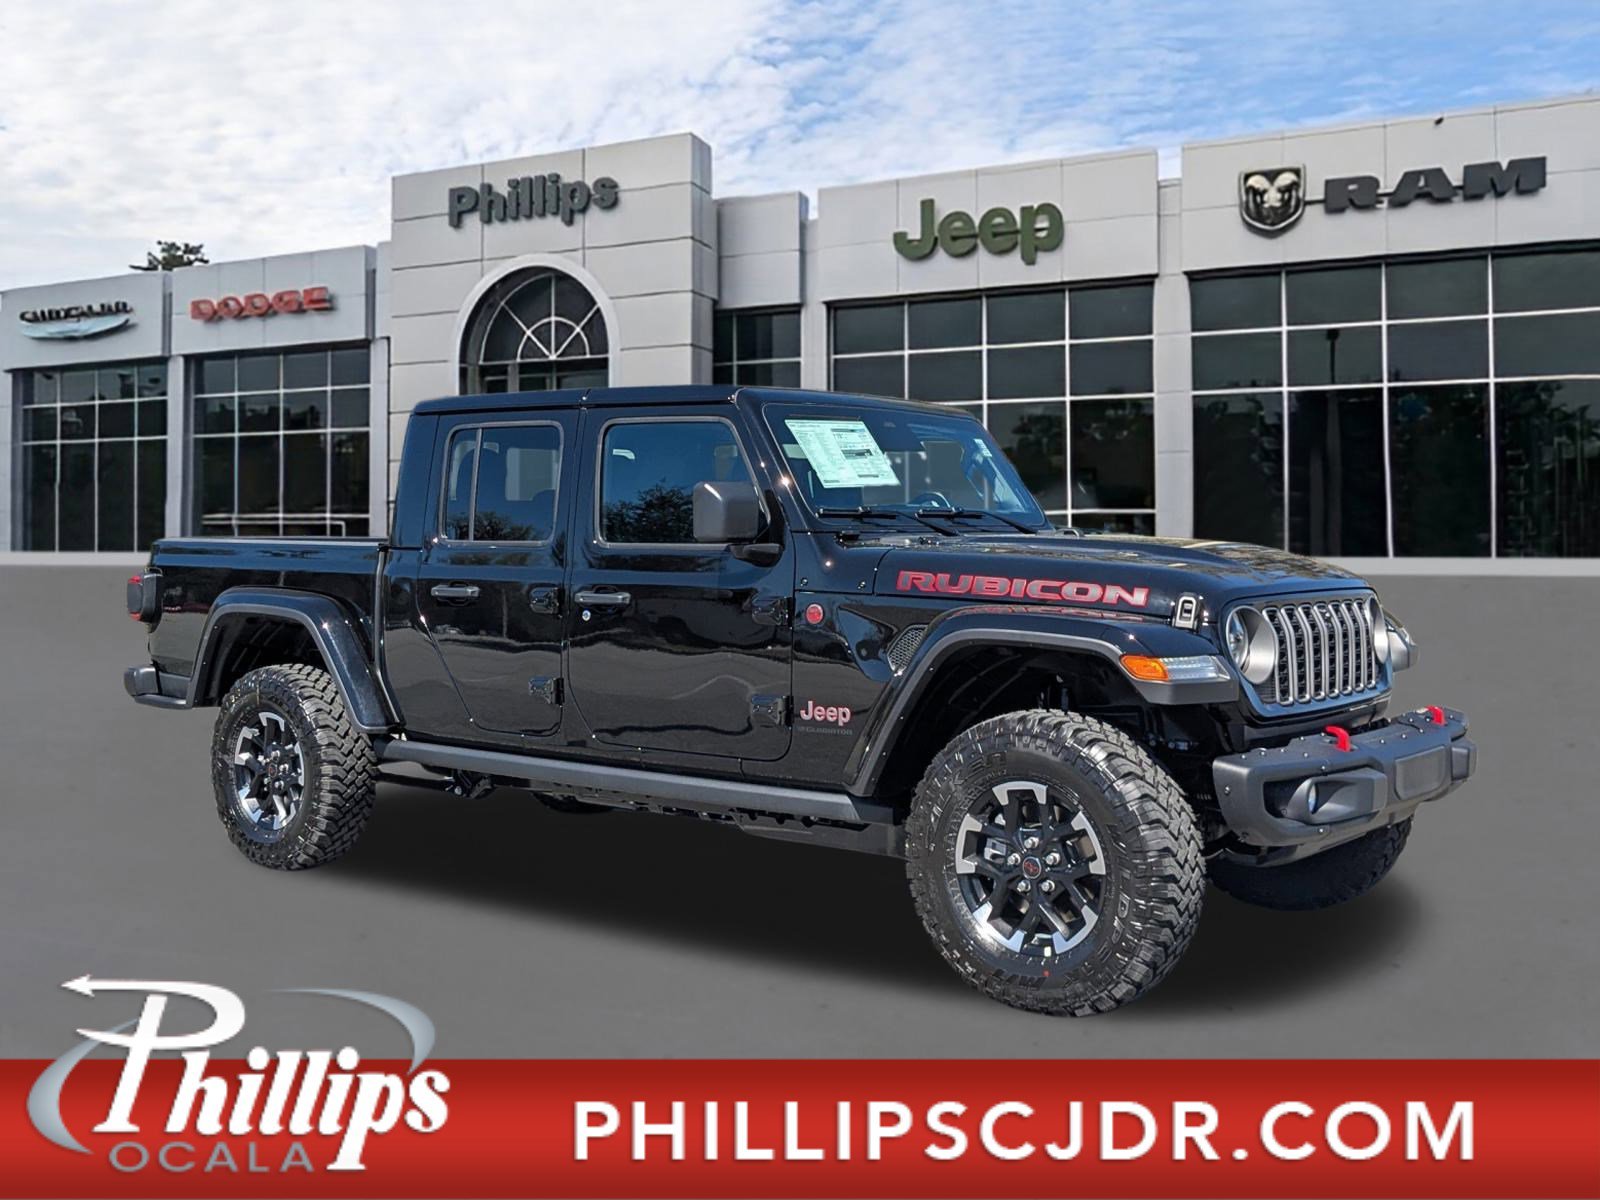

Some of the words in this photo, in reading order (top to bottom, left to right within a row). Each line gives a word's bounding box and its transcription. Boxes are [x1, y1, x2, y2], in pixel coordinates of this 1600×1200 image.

[448, 173, 619, 228] Phillips
[1324, 157, 1547, 214] RAM
[893, 198, 1065, 266] Jeep
[190, 286, 330, 322] DODGE
[896, 570, 1150, 606] RUBICON
[799, 700, 852, 727] Jeep
